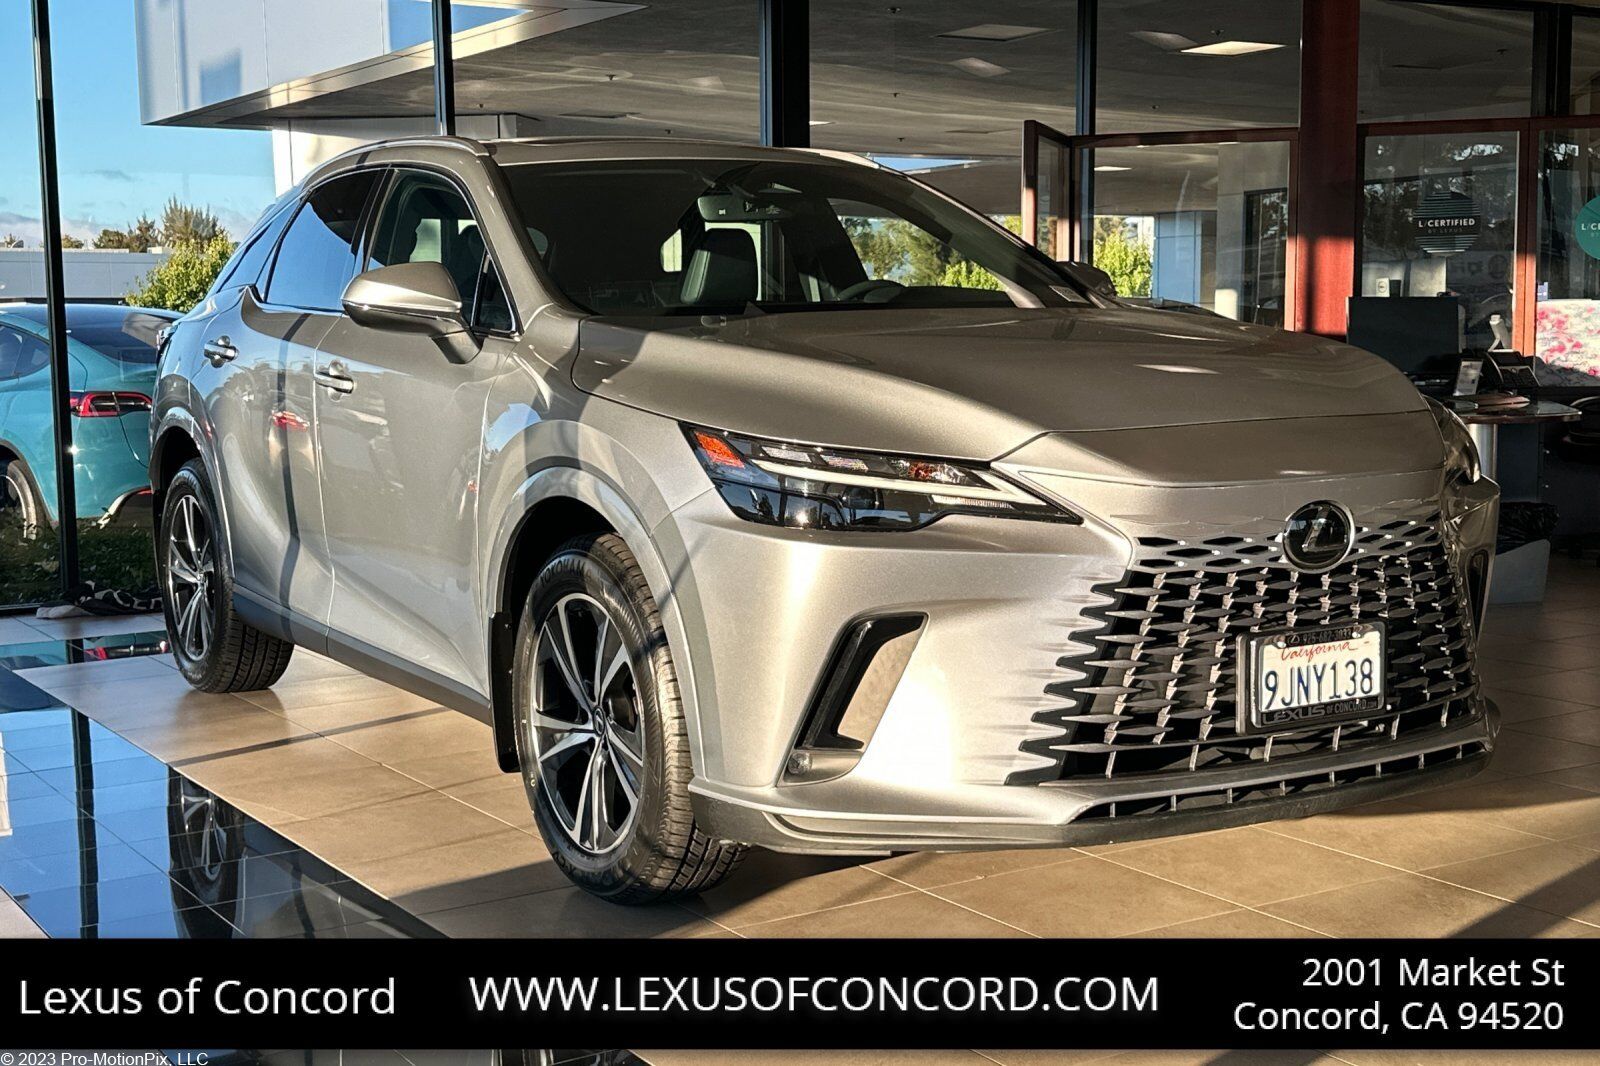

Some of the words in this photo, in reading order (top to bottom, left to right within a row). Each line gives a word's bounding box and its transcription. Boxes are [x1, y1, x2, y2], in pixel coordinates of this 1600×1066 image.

[1280, 640, 1358, 663] California
[1264, 657, 1374, 710] 9JNY138
[1262, 704, 1326, 726] LEXUS
